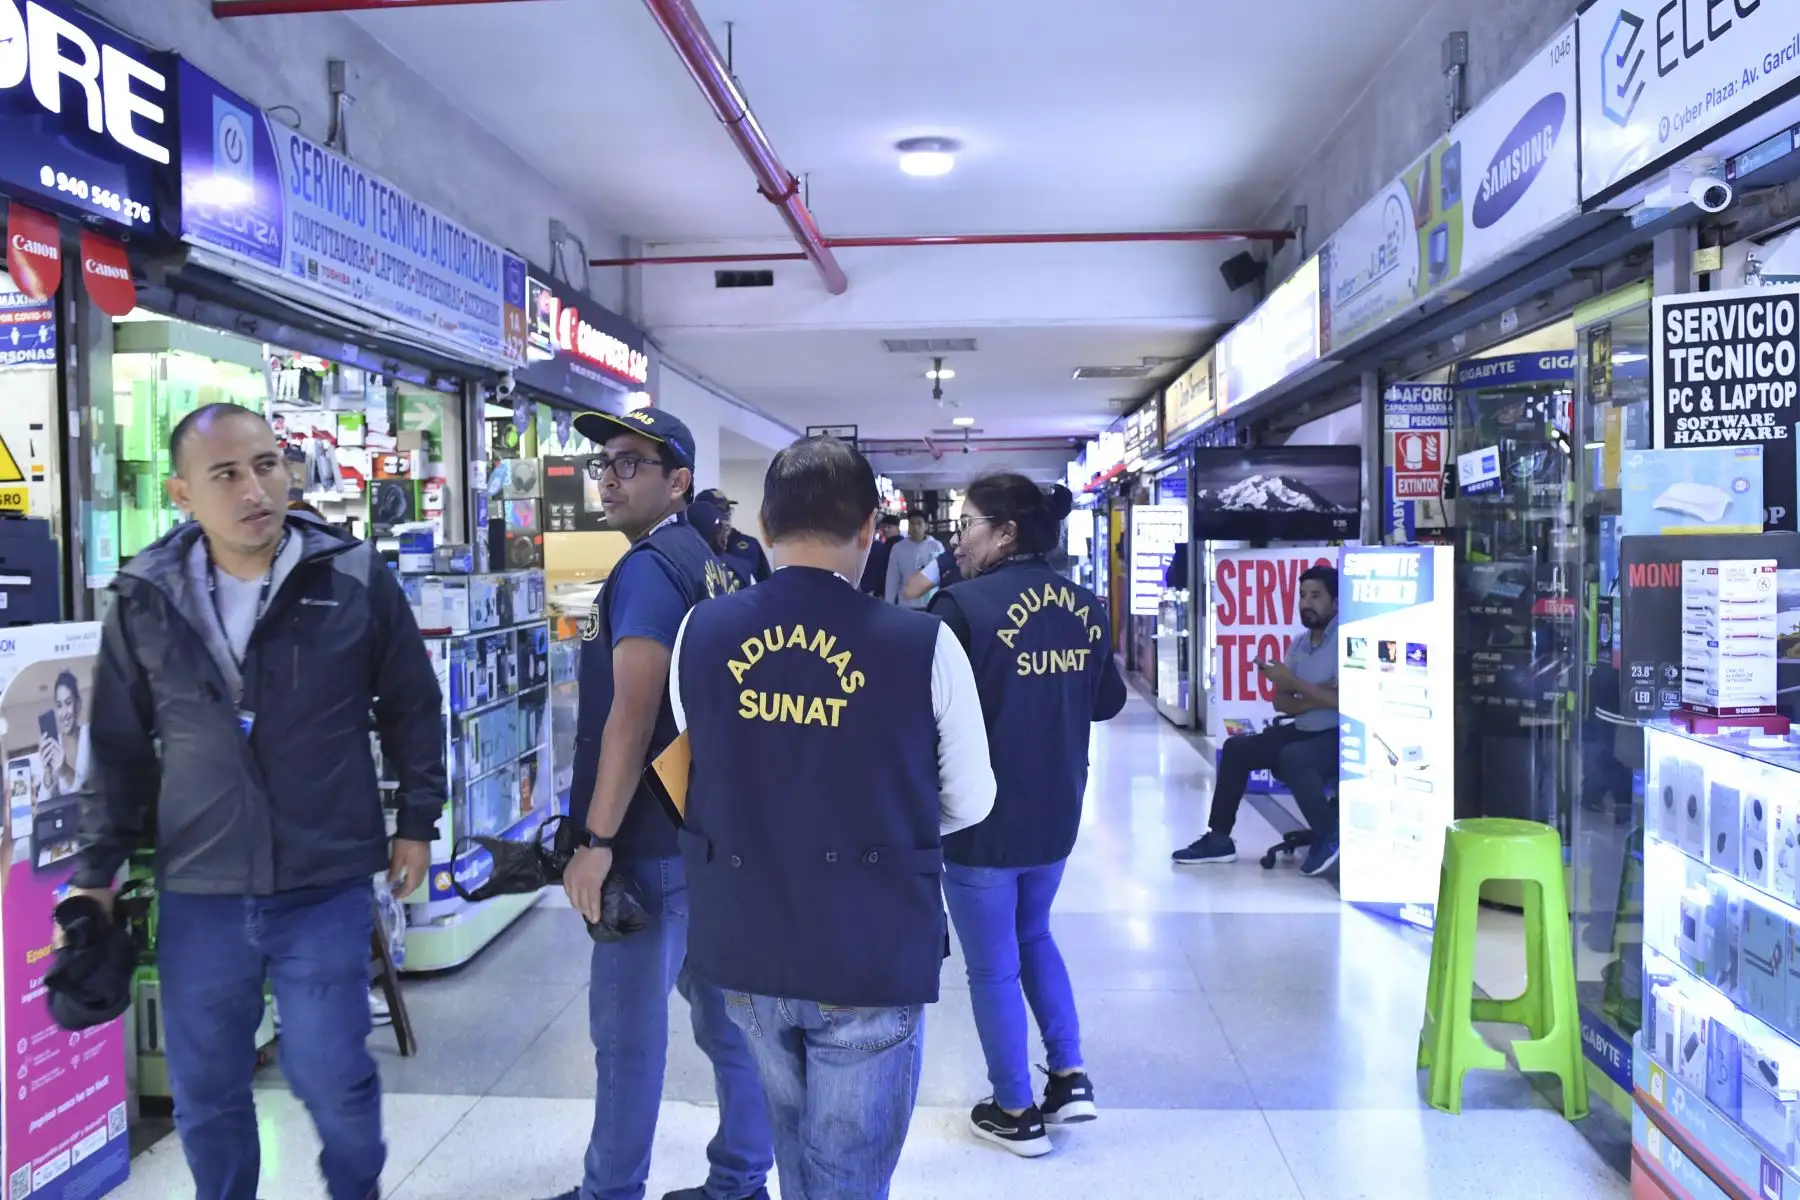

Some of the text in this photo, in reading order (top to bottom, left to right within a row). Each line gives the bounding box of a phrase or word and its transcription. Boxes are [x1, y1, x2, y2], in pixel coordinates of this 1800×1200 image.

[1550, 35, 1571, 67] 1046
[1673, 102, 1703, 131] Cyber
[1705, 79, 1738, 112] Plaza:
[1741, 67, 1759, 90] Av.
[1481, 124, 1553, 201] SAMSUNG
[57, 172, 88, 199] 940
[123, 198, 150, 223] 276
[289, 135, 367, 229] SERVICIO
[370, 180, 427, 258] TECNICO
[430, 215, 499, 293] AUTORIZADO
[12, 234, 58, 260] Canon
[85, 258, 129, 280] Canon
[1666, 300, 1795, 344] SERVICIO
[1460, 361, 1516, 383] GIGABYTE
[1669, 340, 1796, 382] TECNICO
[1669, 381, 1797, 413] PC & LAPTOP
[1674, 426, 1788, 444] HADWARE
[1677, 413, 1776, 431] SOFTWARE
[1398, 478, 1438, 493] EXTINTOR
[997, 583, 1102, 649] ADUANAS
[727, 624, 866, 694] ADUANAS
[1016, 649, 1091, 675] SUNAT
[738, 689, 848, 727] SUNAT
[1635, 691, 1649, 704] LED
